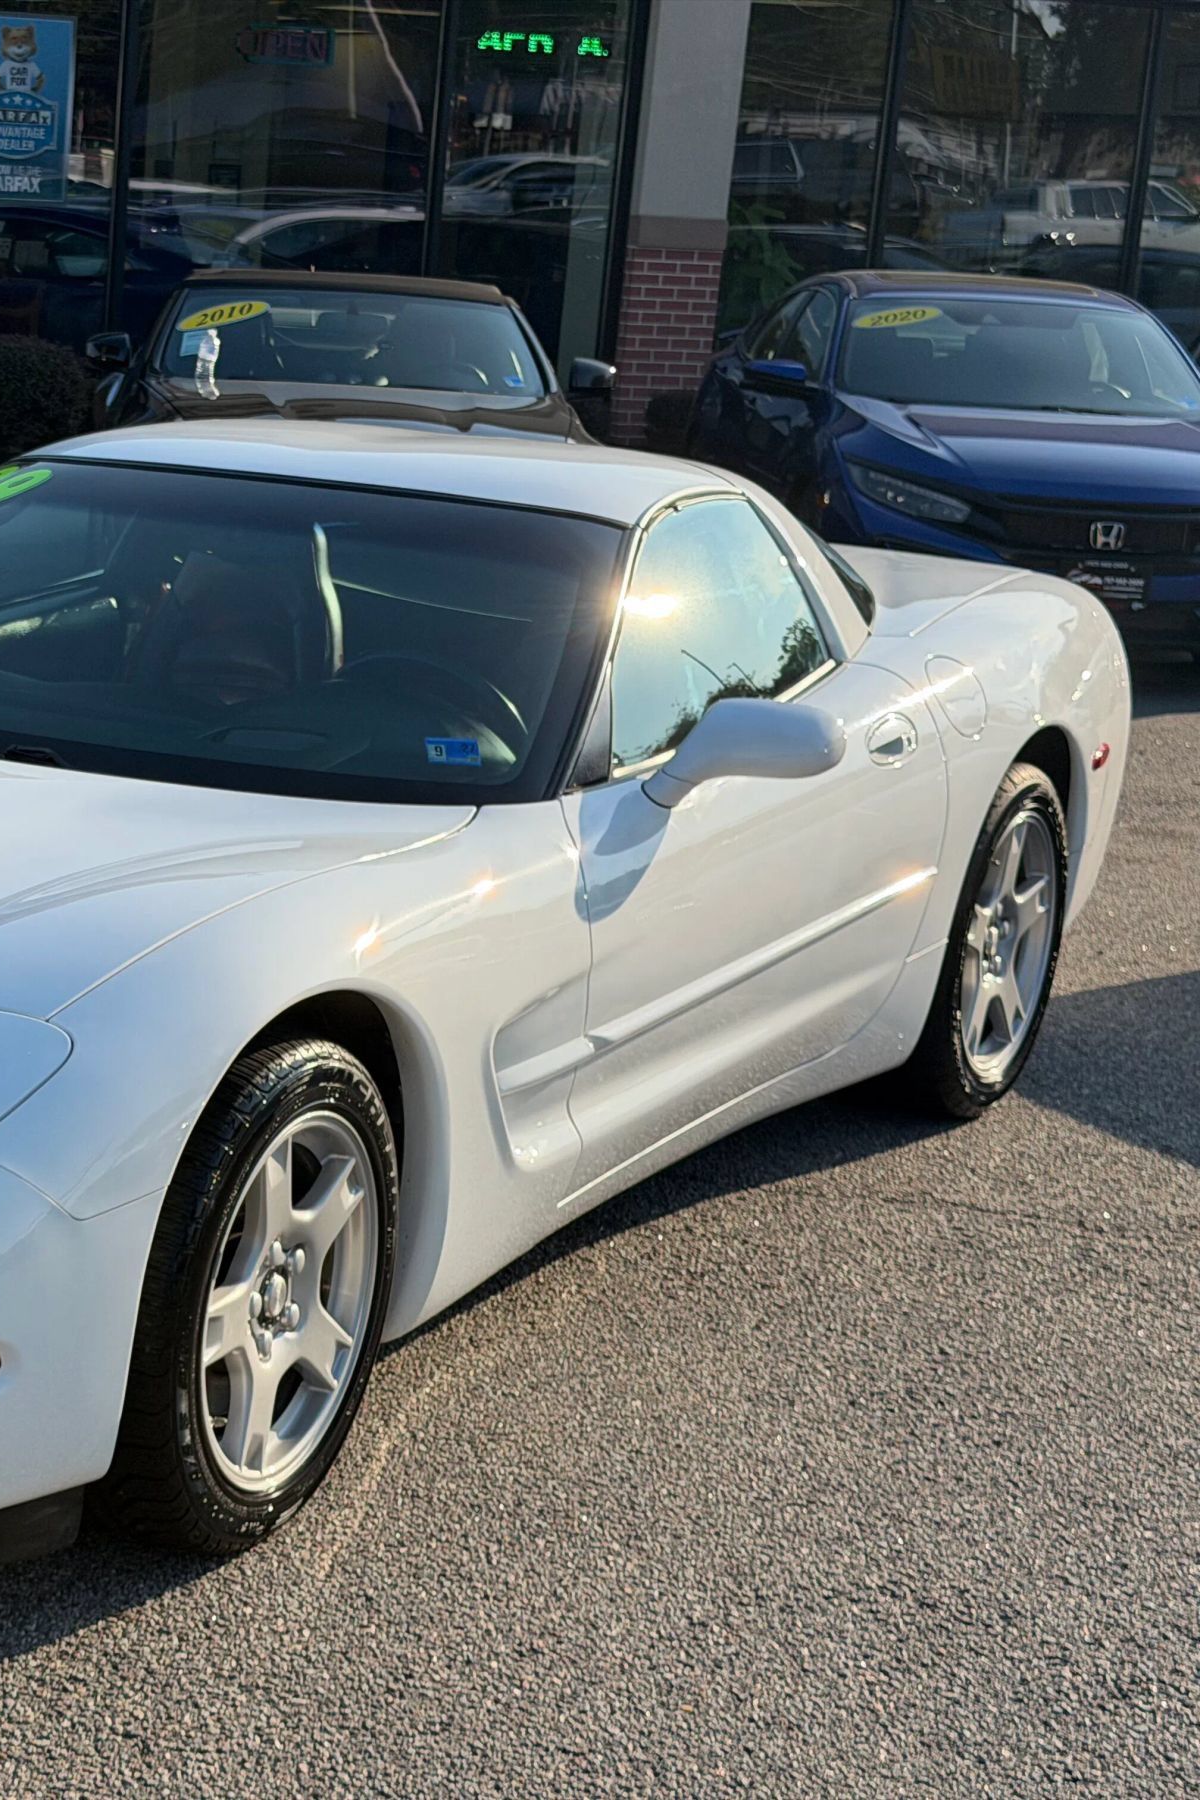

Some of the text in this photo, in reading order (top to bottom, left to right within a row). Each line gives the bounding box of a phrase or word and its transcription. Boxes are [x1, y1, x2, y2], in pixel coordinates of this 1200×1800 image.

[9, 66, 28, 76] CAR
[196, 303, 253, 327] 2010
[871, 309, 926, 327] 2020
[433, 744, 443, 757] 9
